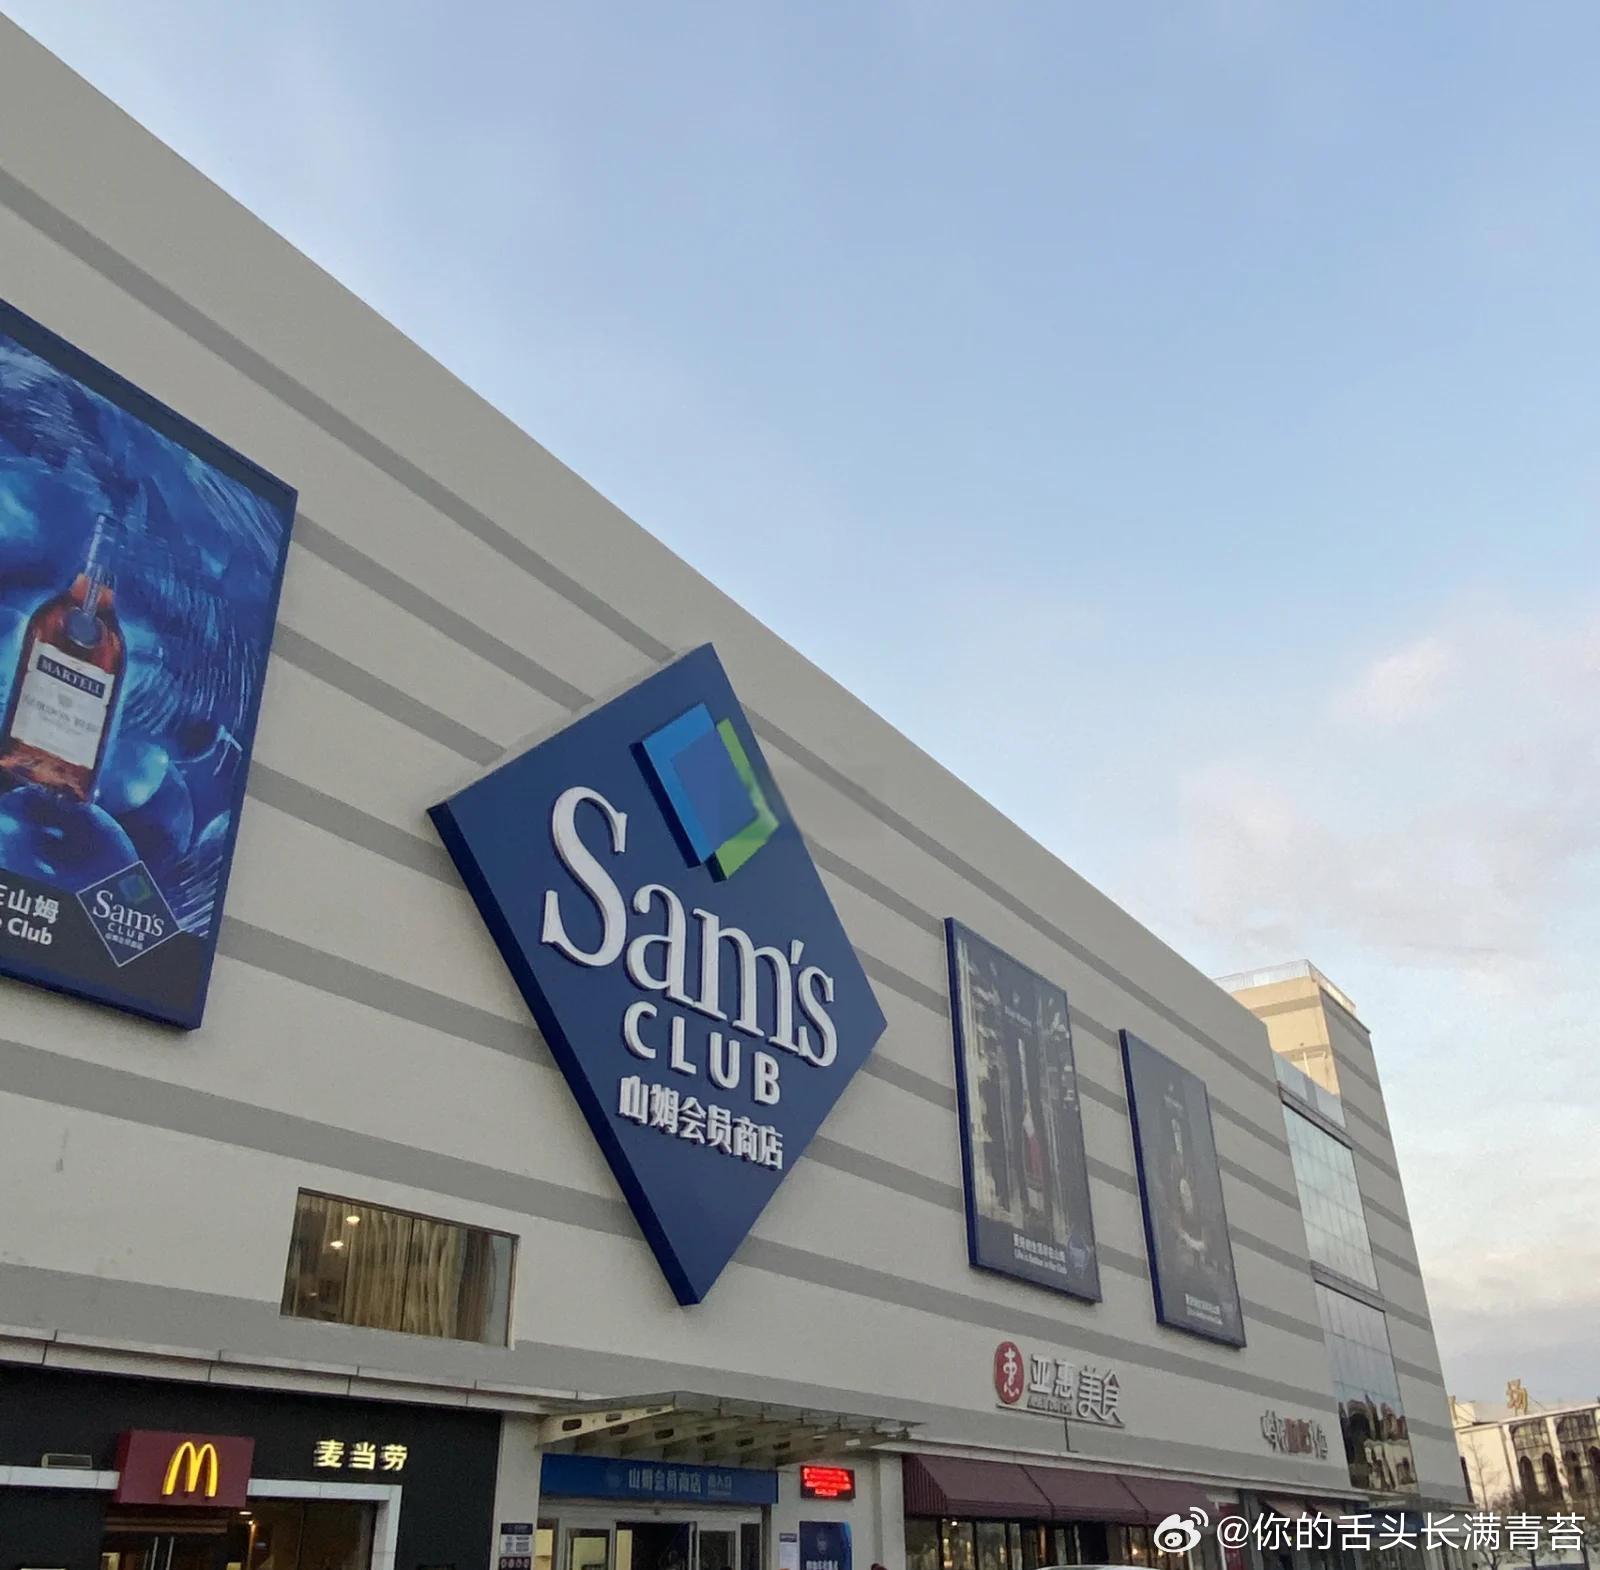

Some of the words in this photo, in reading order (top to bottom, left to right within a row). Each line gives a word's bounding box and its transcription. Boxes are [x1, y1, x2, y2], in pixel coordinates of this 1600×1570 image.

[7, 917, 53, 946] Club
[93, 889, 165, 937] Sam's
[107, 921, 146, 942] CLUB
[541, 786, 839, 1068] Sam's
[622, 1000, 782, 1105] CLUB
[618, 1074, 784, 1171] 山姆会员商店
[1028, 1353, 1122, 1422] 亚惠美食
[313, 1439, 408, 1471] 麦当劳
